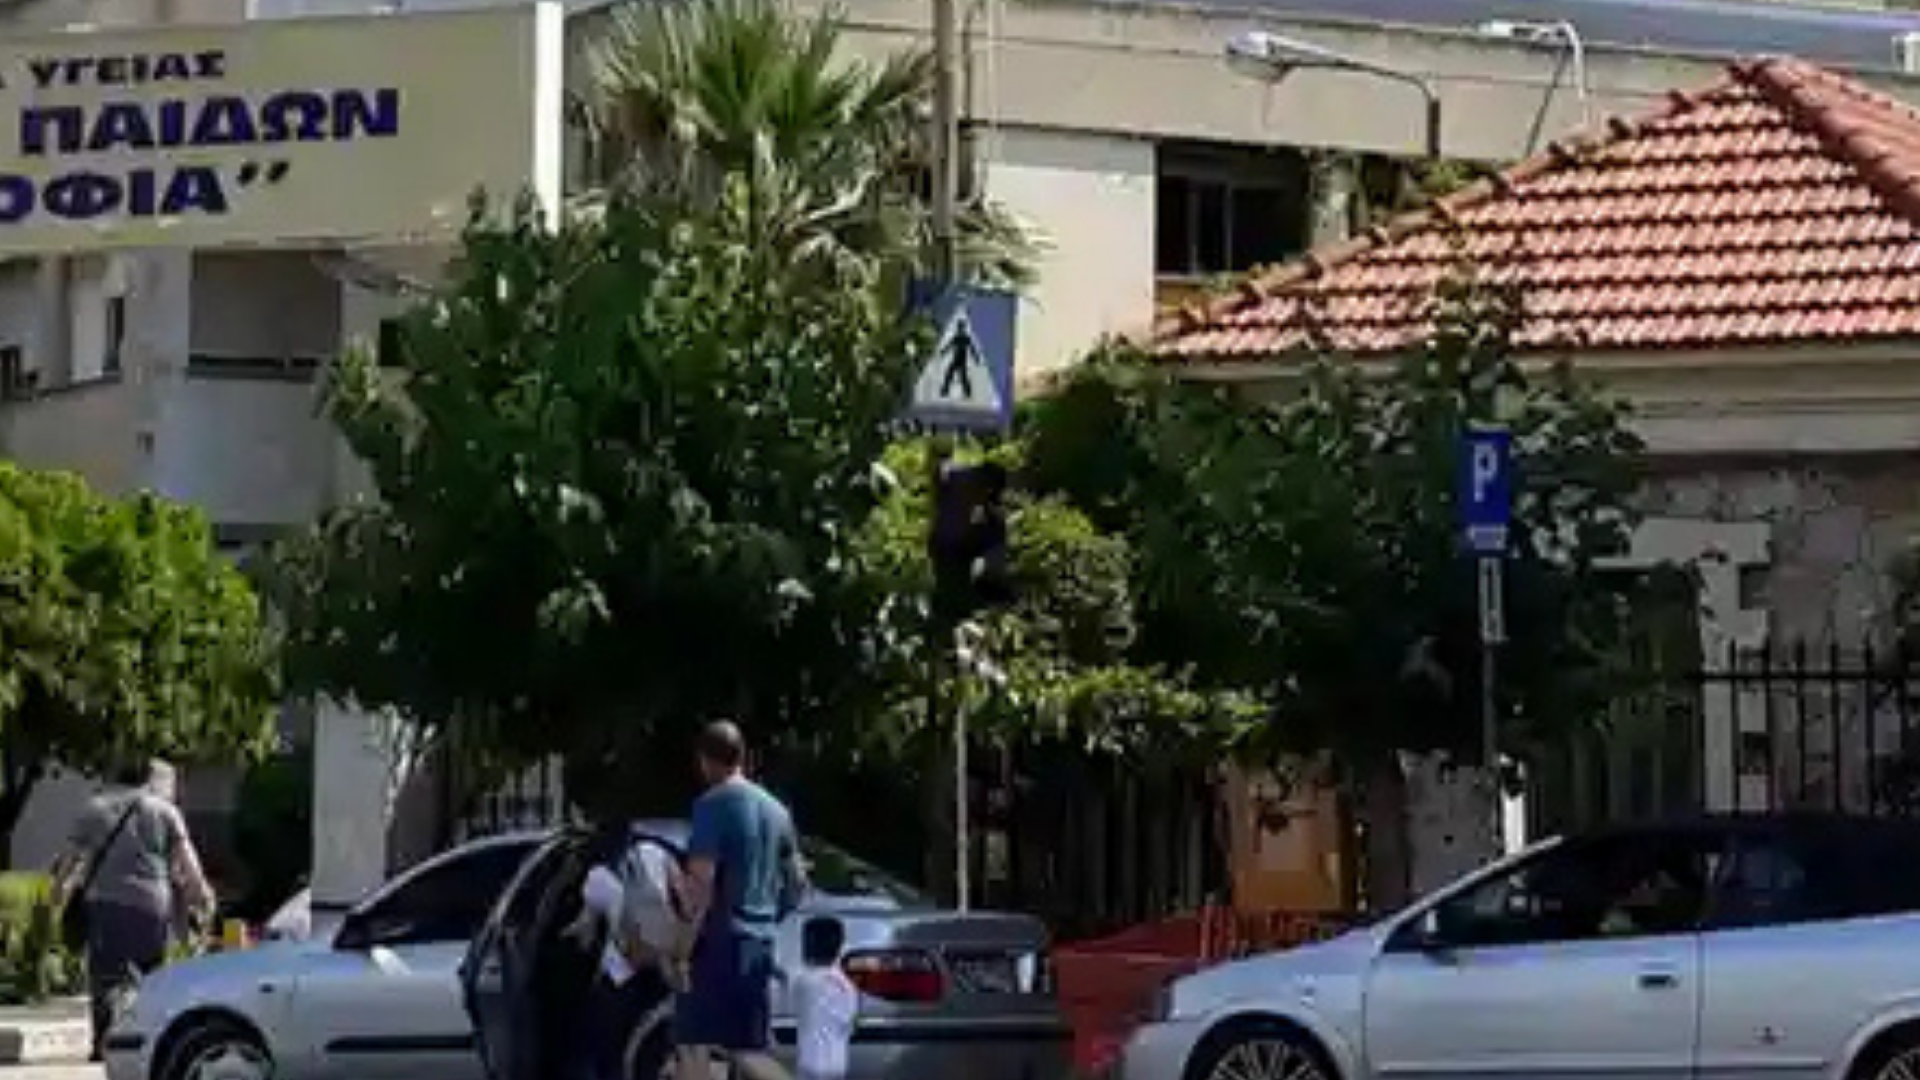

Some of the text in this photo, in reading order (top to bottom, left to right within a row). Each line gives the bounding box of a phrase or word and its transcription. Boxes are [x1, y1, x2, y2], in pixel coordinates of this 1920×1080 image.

[29, 50, 225, 88] ΥΓΕΙΑΣ
[20, 88, 399, 156] ΠΑΙΔΩΝ
[1473, 443, 1499, 503] P
